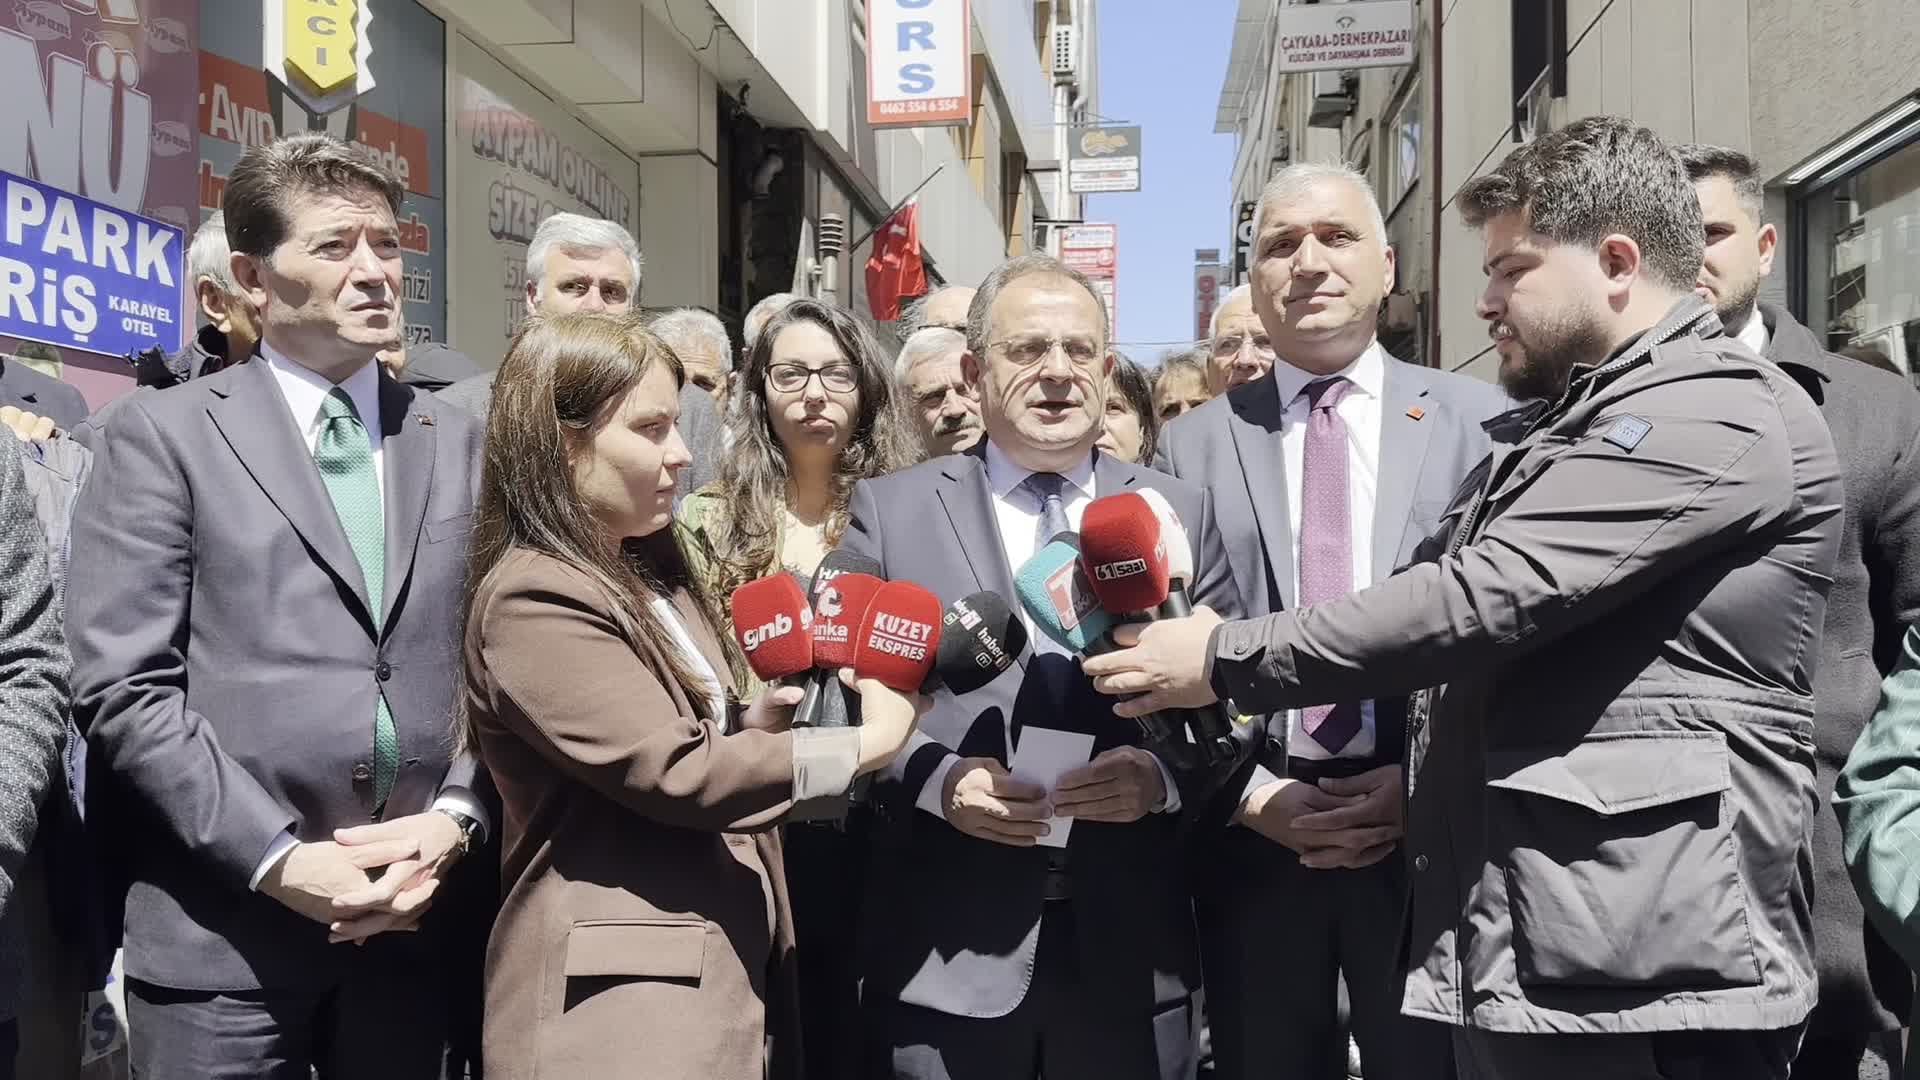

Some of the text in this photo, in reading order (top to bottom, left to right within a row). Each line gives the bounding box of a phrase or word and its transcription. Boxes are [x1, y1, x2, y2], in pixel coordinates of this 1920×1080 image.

[306, 0, 338, 66] CI
[895, 0, 937, 94] RS
[1281, 29, 1411, 54] ÇAYKARA-DERNEKPAZARI
[1318, 51, 1327, 62] VE
[880, 102, 905, 115] 0462
[928, 101, 937, 113] 6
[938, 98, 959, 112] 554
[6, 179, 176, 288] PARK
[108, 295, 174, 324] KARAYEL
[121, 317, 158, 338] OTEL
[743, 613, 793, 651] gnb
[873, 611, 933, 642] KUZEY
[867, 634, 927, 662] EKSPRES
[977, 627, 1004, 658] haber
